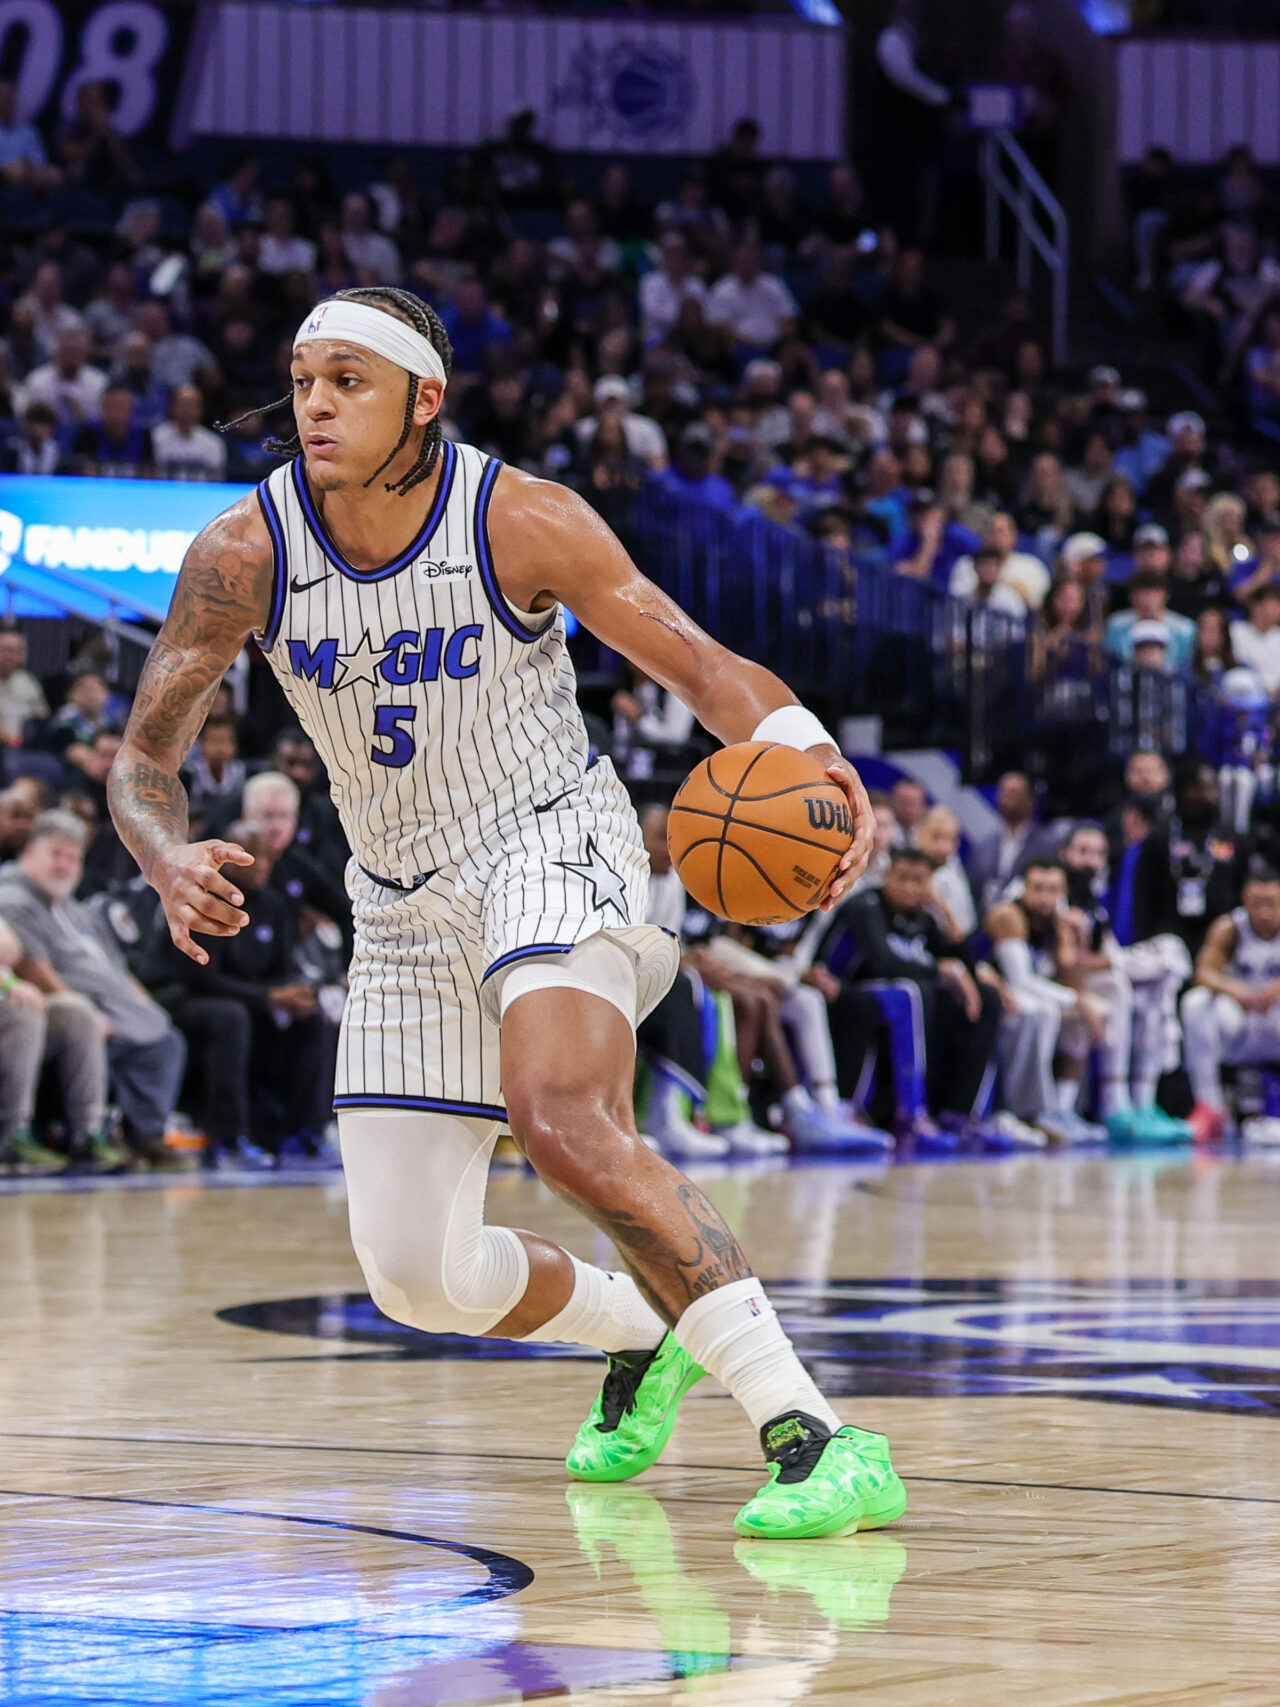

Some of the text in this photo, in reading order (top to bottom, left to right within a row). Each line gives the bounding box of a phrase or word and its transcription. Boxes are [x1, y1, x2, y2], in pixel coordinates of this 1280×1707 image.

[24, 524, 197, 574] FANDUE
[419, 561, 473, 579] Disney
[370, 705, 417, 769] 5
